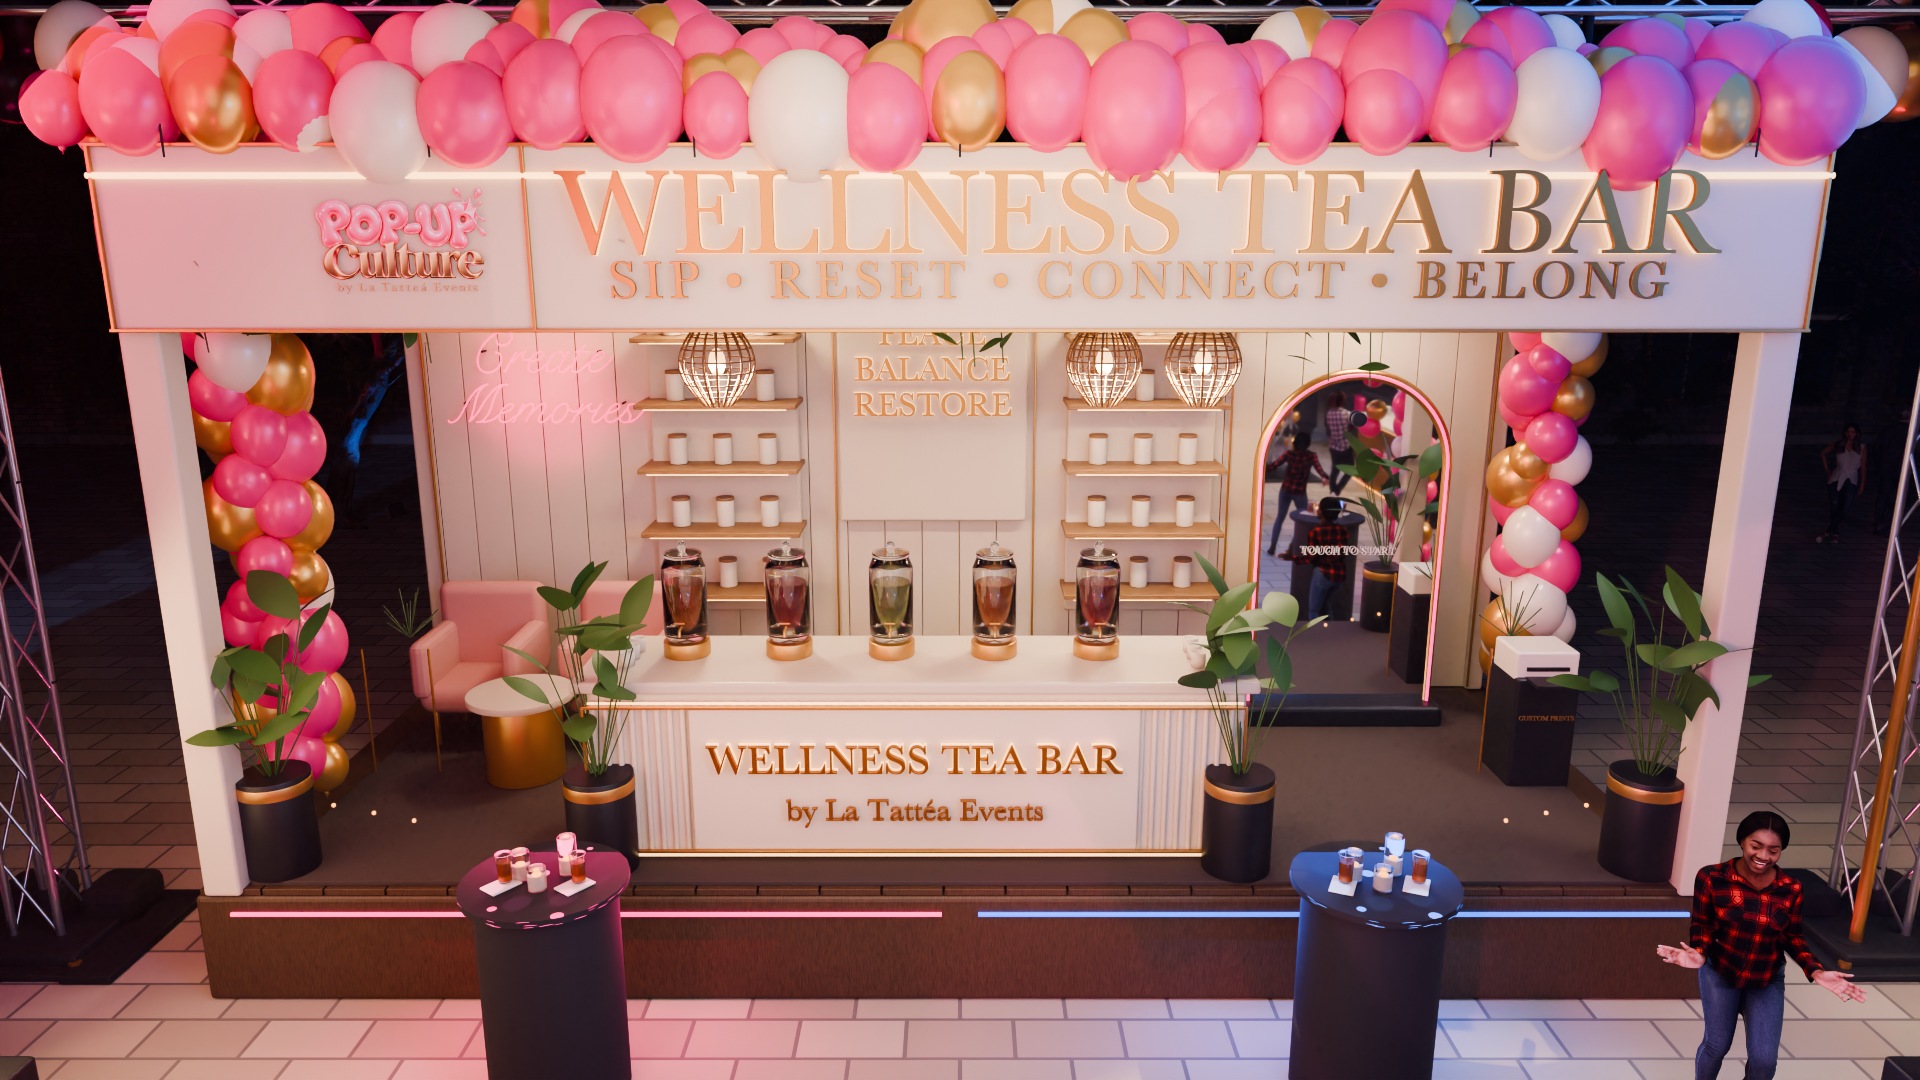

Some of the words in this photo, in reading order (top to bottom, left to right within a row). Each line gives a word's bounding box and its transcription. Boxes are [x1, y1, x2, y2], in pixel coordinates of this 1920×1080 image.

[315, 199, 478, 249] POP-UP
[553, 168, 1179, 257] WELLNESS
[1217, 169, 1453, 255] TEA
[1479, 169, 1722, 255] BAR
[323, 242, 485, 280] Culture
[337, 283, 352, 294] by
[359, 283, 376, 292] La
[434, 282, 479, 293] Events
[610, 260, 700, 300] SIP
[769, 260, 966, 300] RESET
[1037, 260, 1346, 300] CONNECT
[1413, 260, 1670, 300] BELONG
[476, 332, 613, 375] Create
[854, 356, 1011, 382] BALANCE
[447, 383, 644, 424] Memories
[853, 391, 1012, 417] RESTORE
[1300, 546, 1341, 556] TOUCH
[1342, 546, 1359, 556] TO
[1361, 546, 1396, 556] START
[705, 743, 930, 775] WELLNESS
[941, 743, 1028, 775] TEA
[1035, 743, 1123, 775] BAR
[786, 799, 816, 828] by
[825, 799, 860, 822] La
[867, 799, 952, 822] Tattéa
[959, 798, 1044, 822] Events
